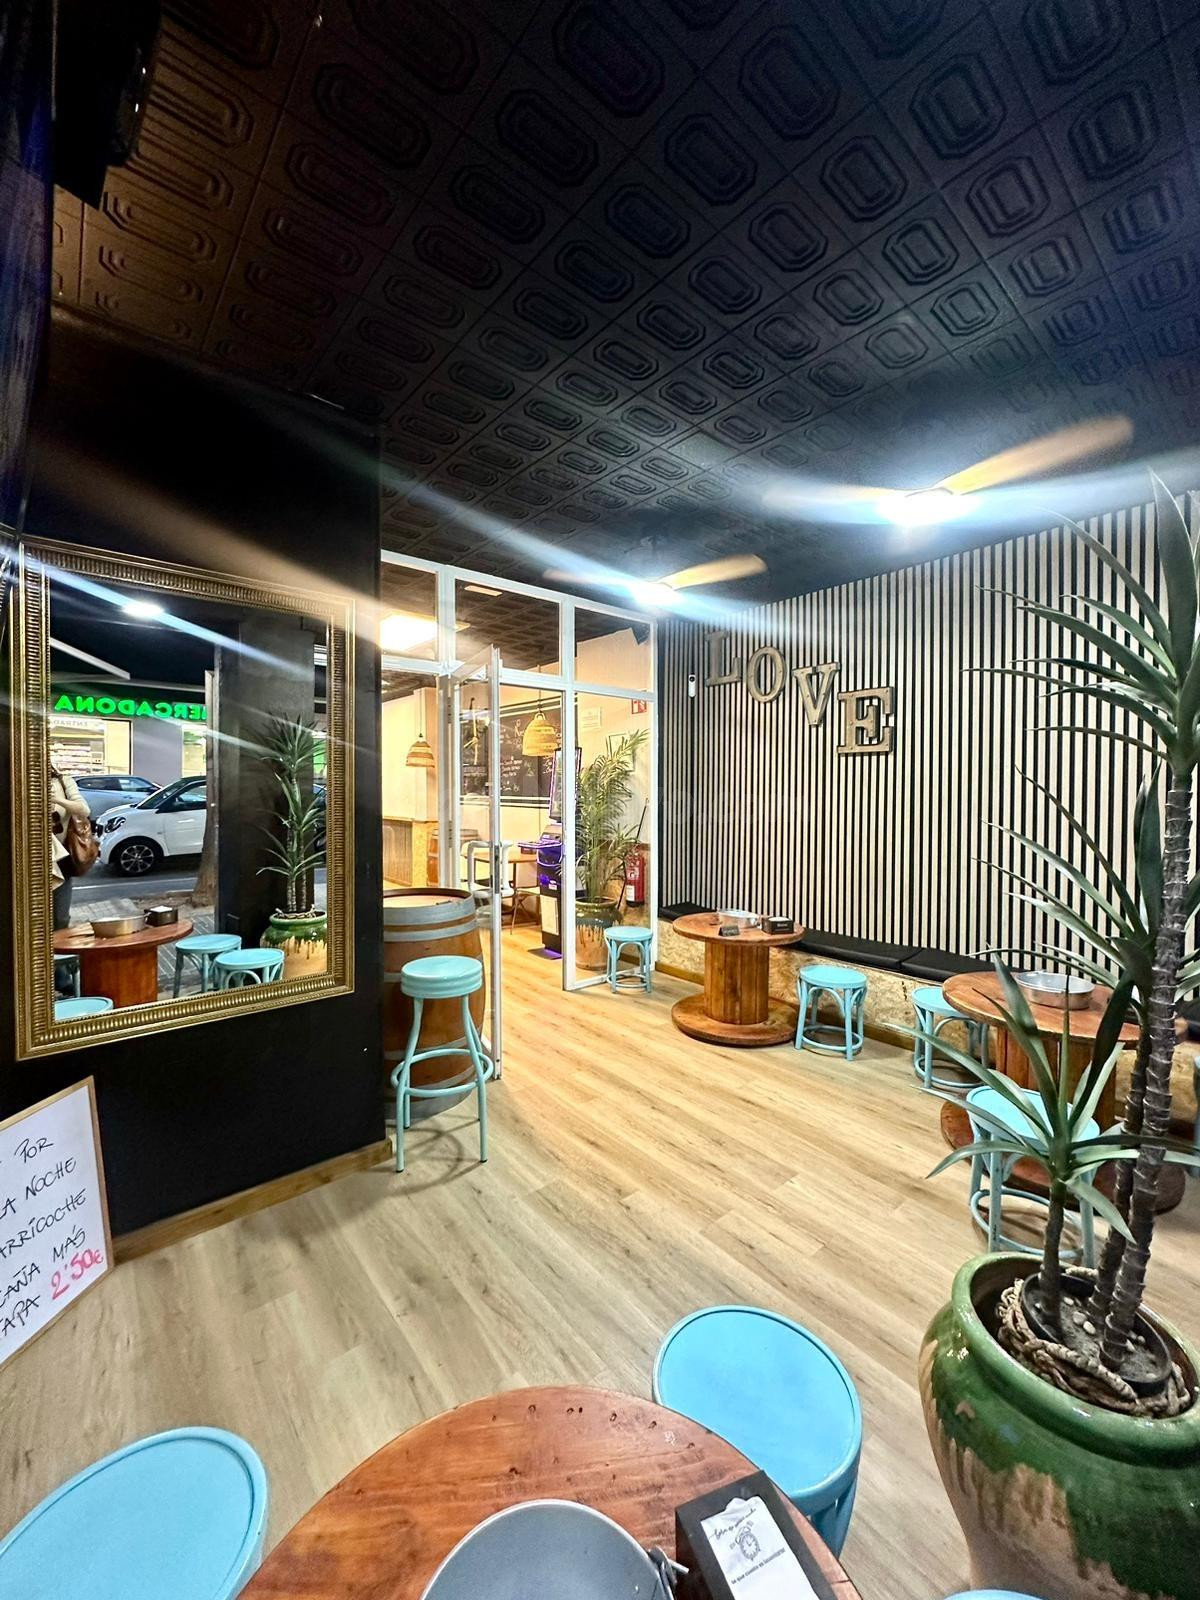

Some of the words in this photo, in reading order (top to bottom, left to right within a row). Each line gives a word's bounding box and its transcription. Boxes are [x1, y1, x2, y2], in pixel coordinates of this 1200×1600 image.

[705, 630, 895, 756] LOVE
[14, 1137, 54, 1163] POR
[26, 1156, 77, 1200] NOCHE
[0, 1294, 41, 1337] APA
